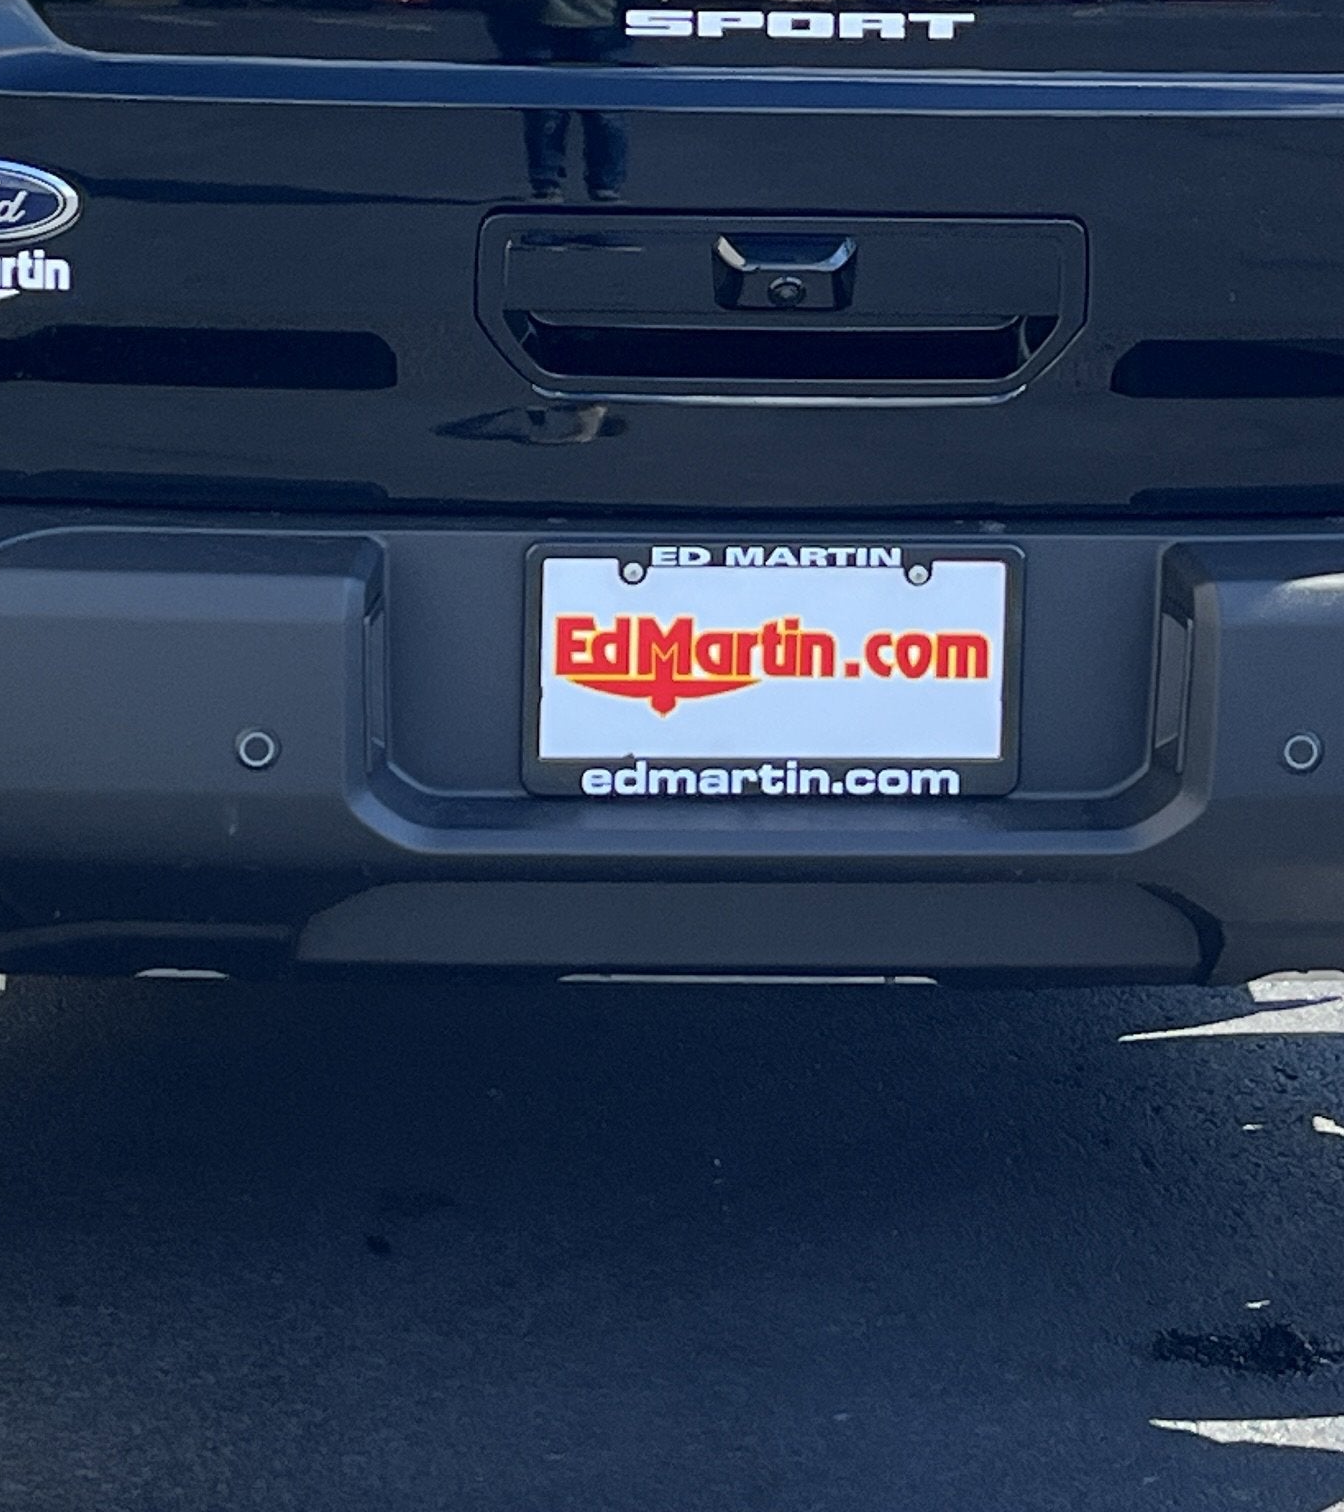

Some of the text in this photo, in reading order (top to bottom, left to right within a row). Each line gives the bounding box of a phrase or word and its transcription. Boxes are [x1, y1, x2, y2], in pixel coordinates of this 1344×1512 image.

[625, 9, 975, 39] SPORT
[651, 546, 902, 568] ED MARTIN
[554, 617, 989, 679] EdMartin.com
[581, 759, 960, 796] edmartin.com
